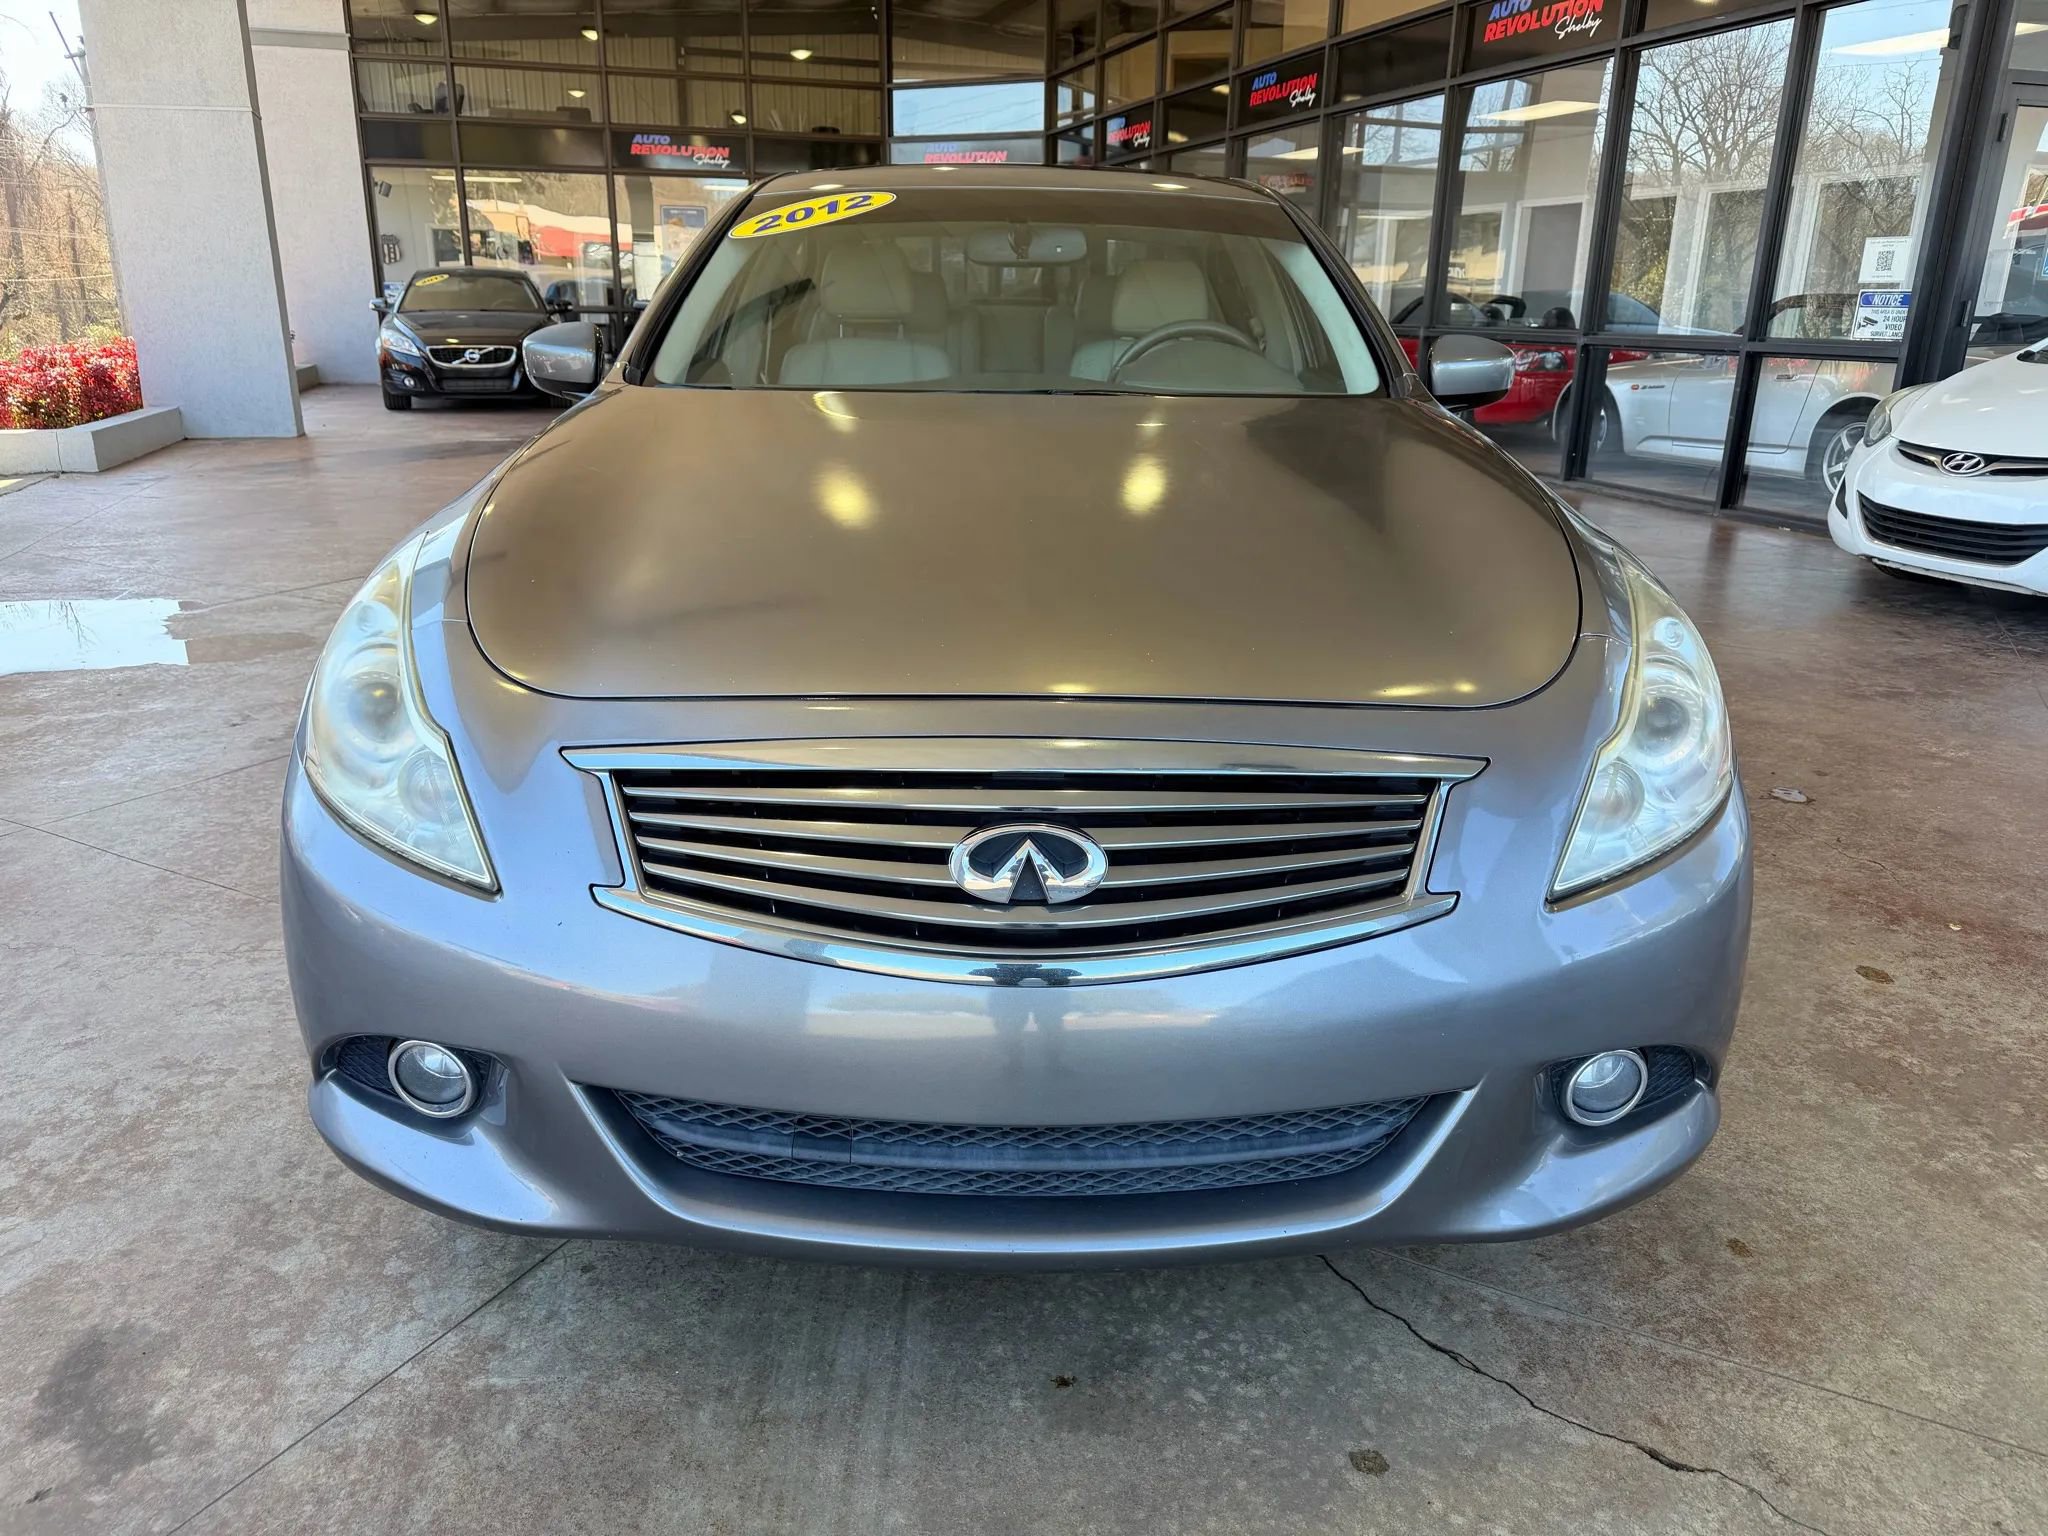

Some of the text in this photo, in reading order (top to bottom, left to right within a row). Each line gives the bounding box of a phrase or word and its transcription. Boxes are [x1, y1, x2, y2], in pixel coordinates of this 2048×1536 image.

[1488, 0, 1532, 21] AUTO
[1484, 0, 1604, 43] REVOLUTION
[1554, 9, 1602, 40] Shelby
[1252, 72, 1278, 90] AUTO
[1249, 73, 1318, 107] REVOLUTION
[632, 134, 670, 144] AUTO
[630, 144, 730, 158] REVOLUTION
[925, 150, 1008, 164] REVOLUTION
[693, 153, 730, 168] Shelby
[752, 195, 875, 234] 2012
[1872, 294, 1904, 306] NOTICE
[1885, 323, 1902, 331] VIDEO
